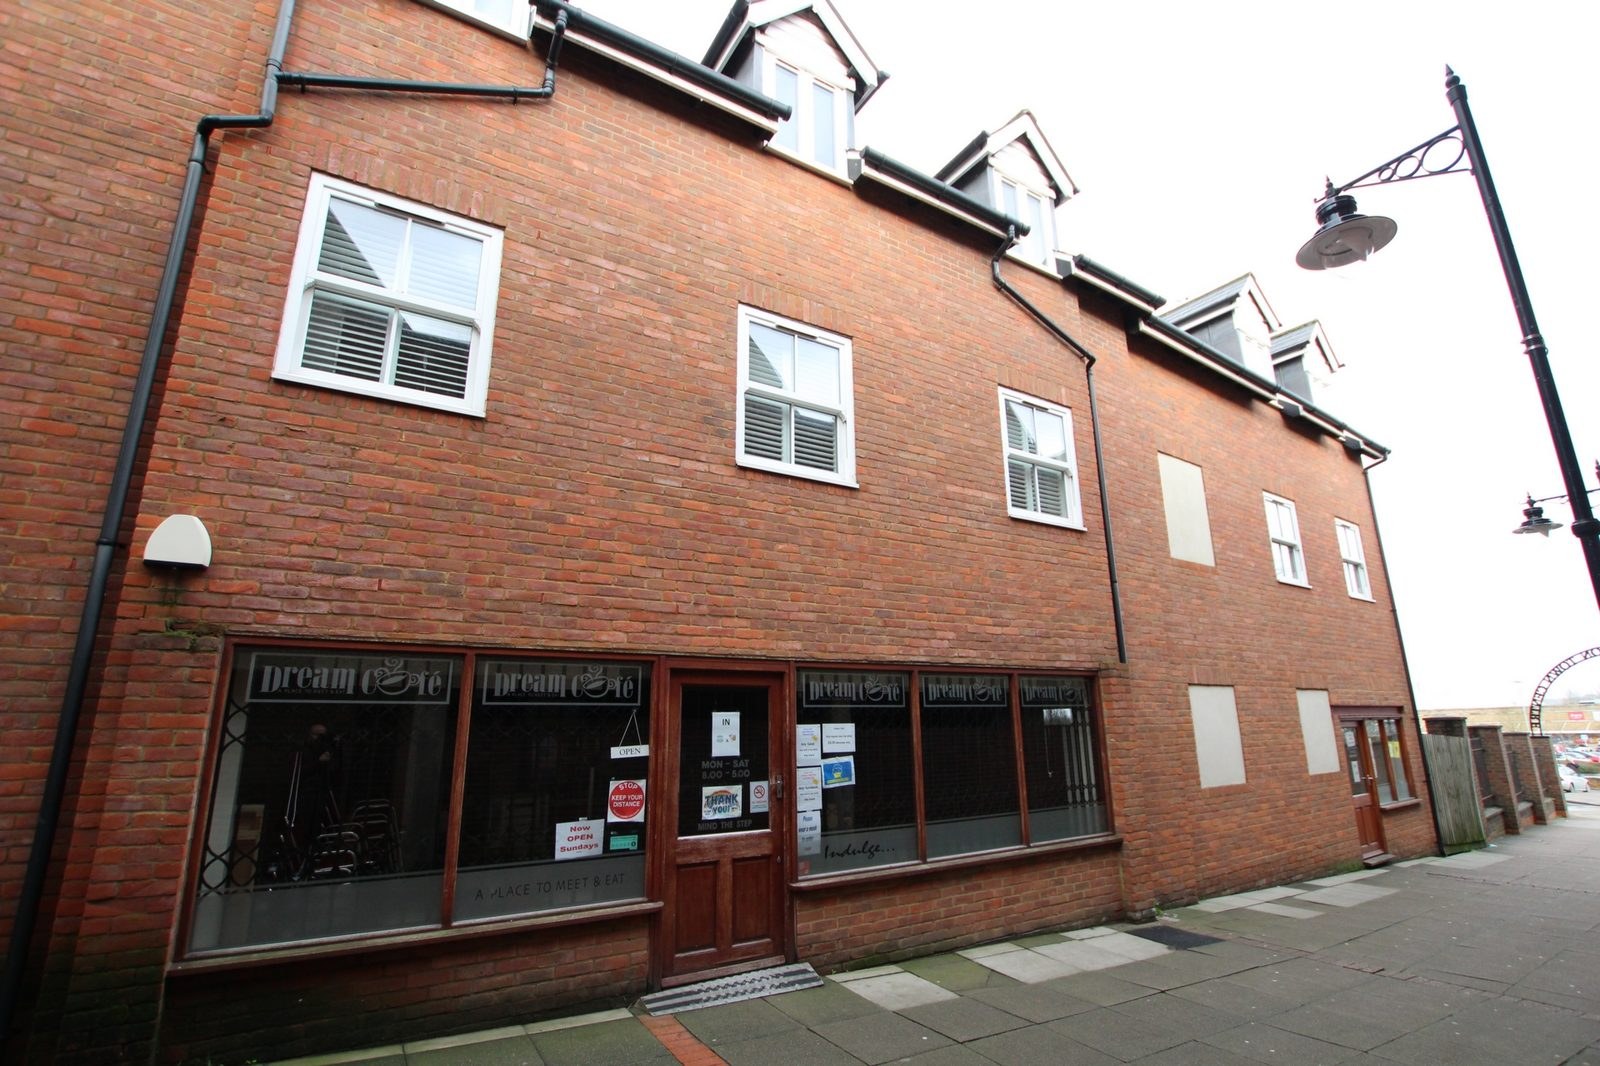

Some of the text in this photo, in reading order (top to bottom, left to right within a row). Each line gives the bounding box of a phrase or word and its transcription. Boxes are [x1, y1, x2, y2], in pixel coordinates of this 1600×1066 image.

[722, 718, 730, 726] IN
[619, 747, 641, 756] OPEN
[701, 760, 723, 769] MON
[733, 759, 750, 768] SAT
[619, 782, 638, 791] STOP
[704, 794, 739, 807] THANK
[712, 805, 730, 815] YOU!
[569, 825, 591, 833] Now
[697, 819, 753, 831] MIND THE STEP
[567, 833, 594, 842] OPEN
[559, 842, 599, 853] Sundays
[474, 889, 484, 901] A
[536, 882, 552, 894] TO
[555, 876, 588, 891] MEET
[593, 875, 602, 888] &
[605, 873, 625, 886] EAT
